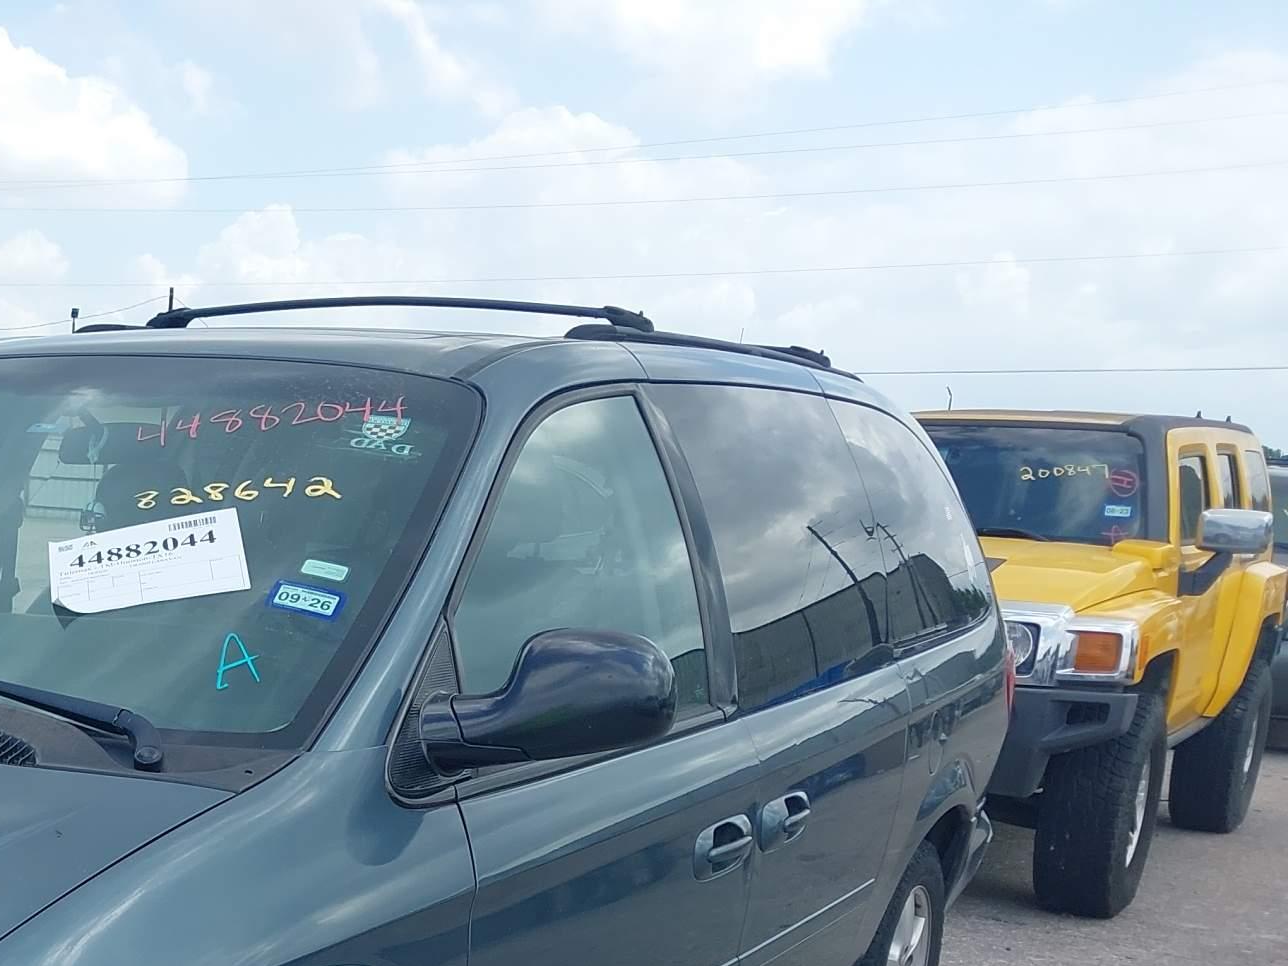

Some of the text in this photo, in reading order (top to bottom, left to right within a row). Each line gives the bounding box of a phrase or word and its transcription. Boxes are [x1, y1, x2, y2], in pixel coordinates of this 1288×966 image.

[137, 396, 408, 446] 44882044
[1020, 464, 1108, 480] 200847
[134, 476, 342, 509] 828642
[70, 529, 217, 568] 44882044
[217, 633, 260, 690] A
